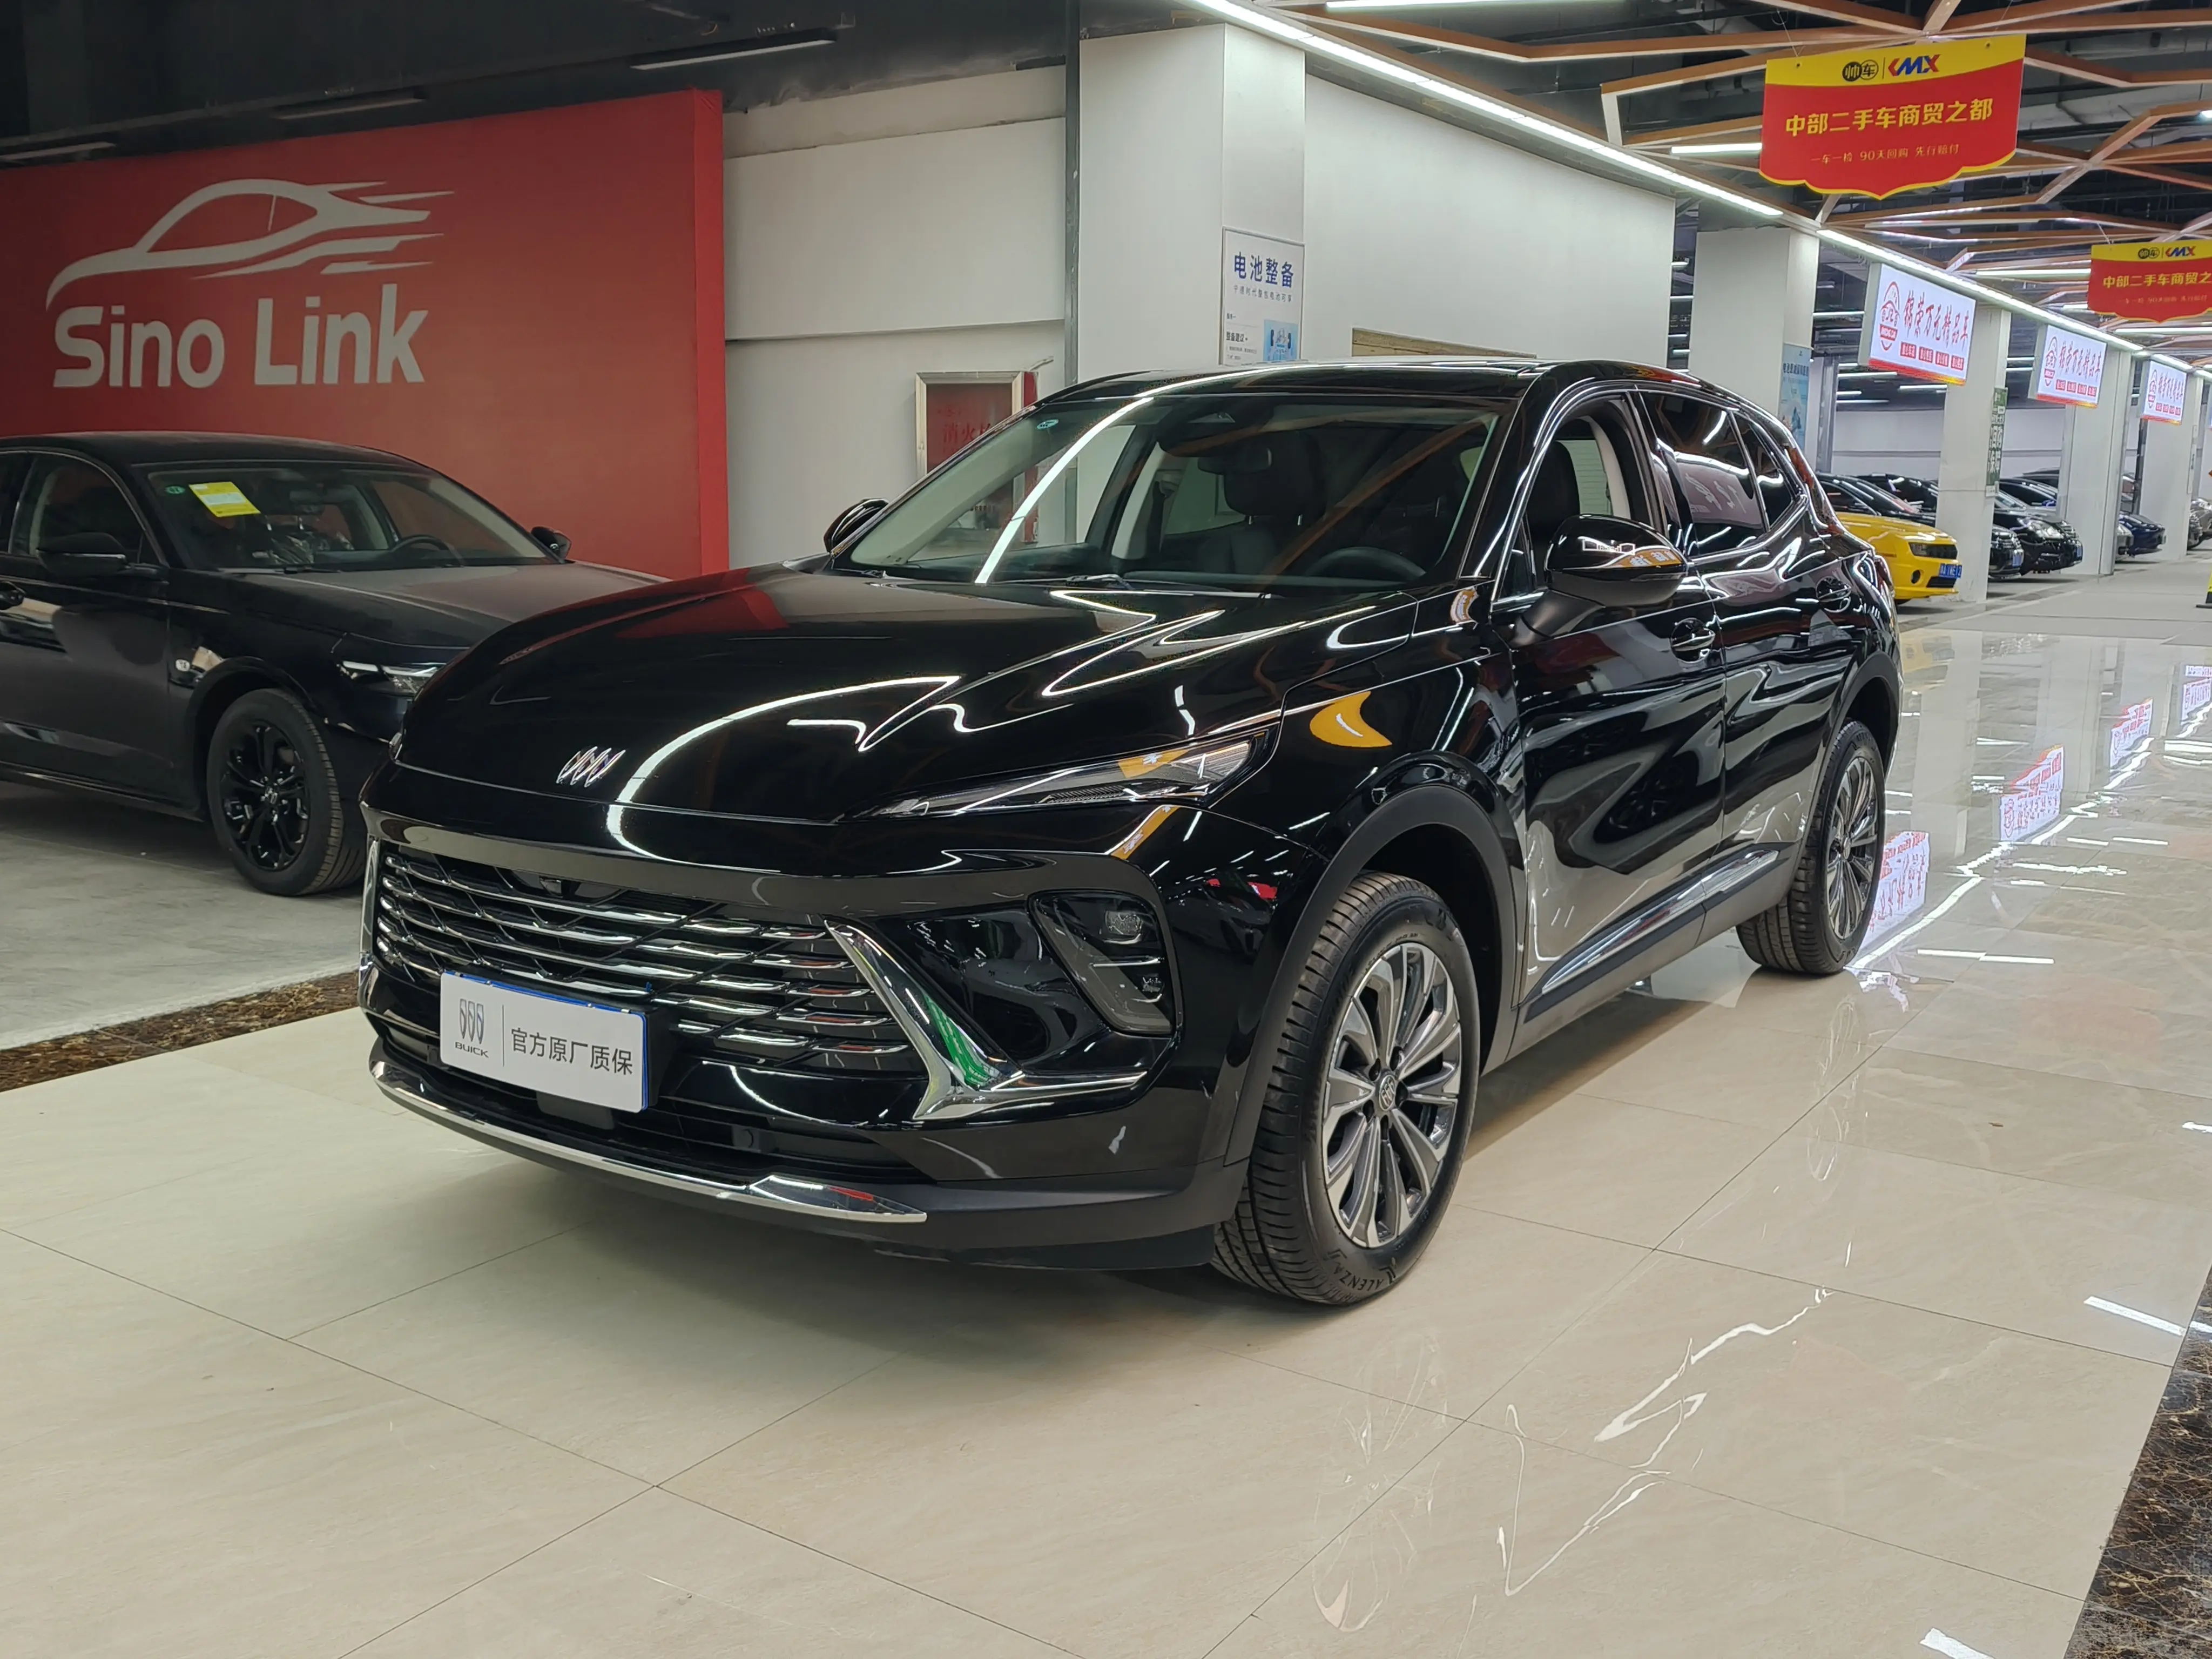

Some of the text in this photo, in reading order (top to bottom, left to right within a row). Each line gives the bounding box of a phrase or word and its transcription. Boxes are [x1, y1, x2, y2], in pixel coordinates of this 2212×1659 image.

[1785, 98, 1993, 137] 中部二手车商贸之都
[1860, 147, 1908, 161] 90天回购
[1915, 143, 1959, 157] 先行赔付
[1234, 252, 1293, 288] 电池整备
[53, 283, 429, 388] Sino Link
[455, 1041, 489, 1058] BUICK
[511, 1028, 633, 1075] 官方原厂质保
[1333, 1262, 1384, 1291] ALENZA
